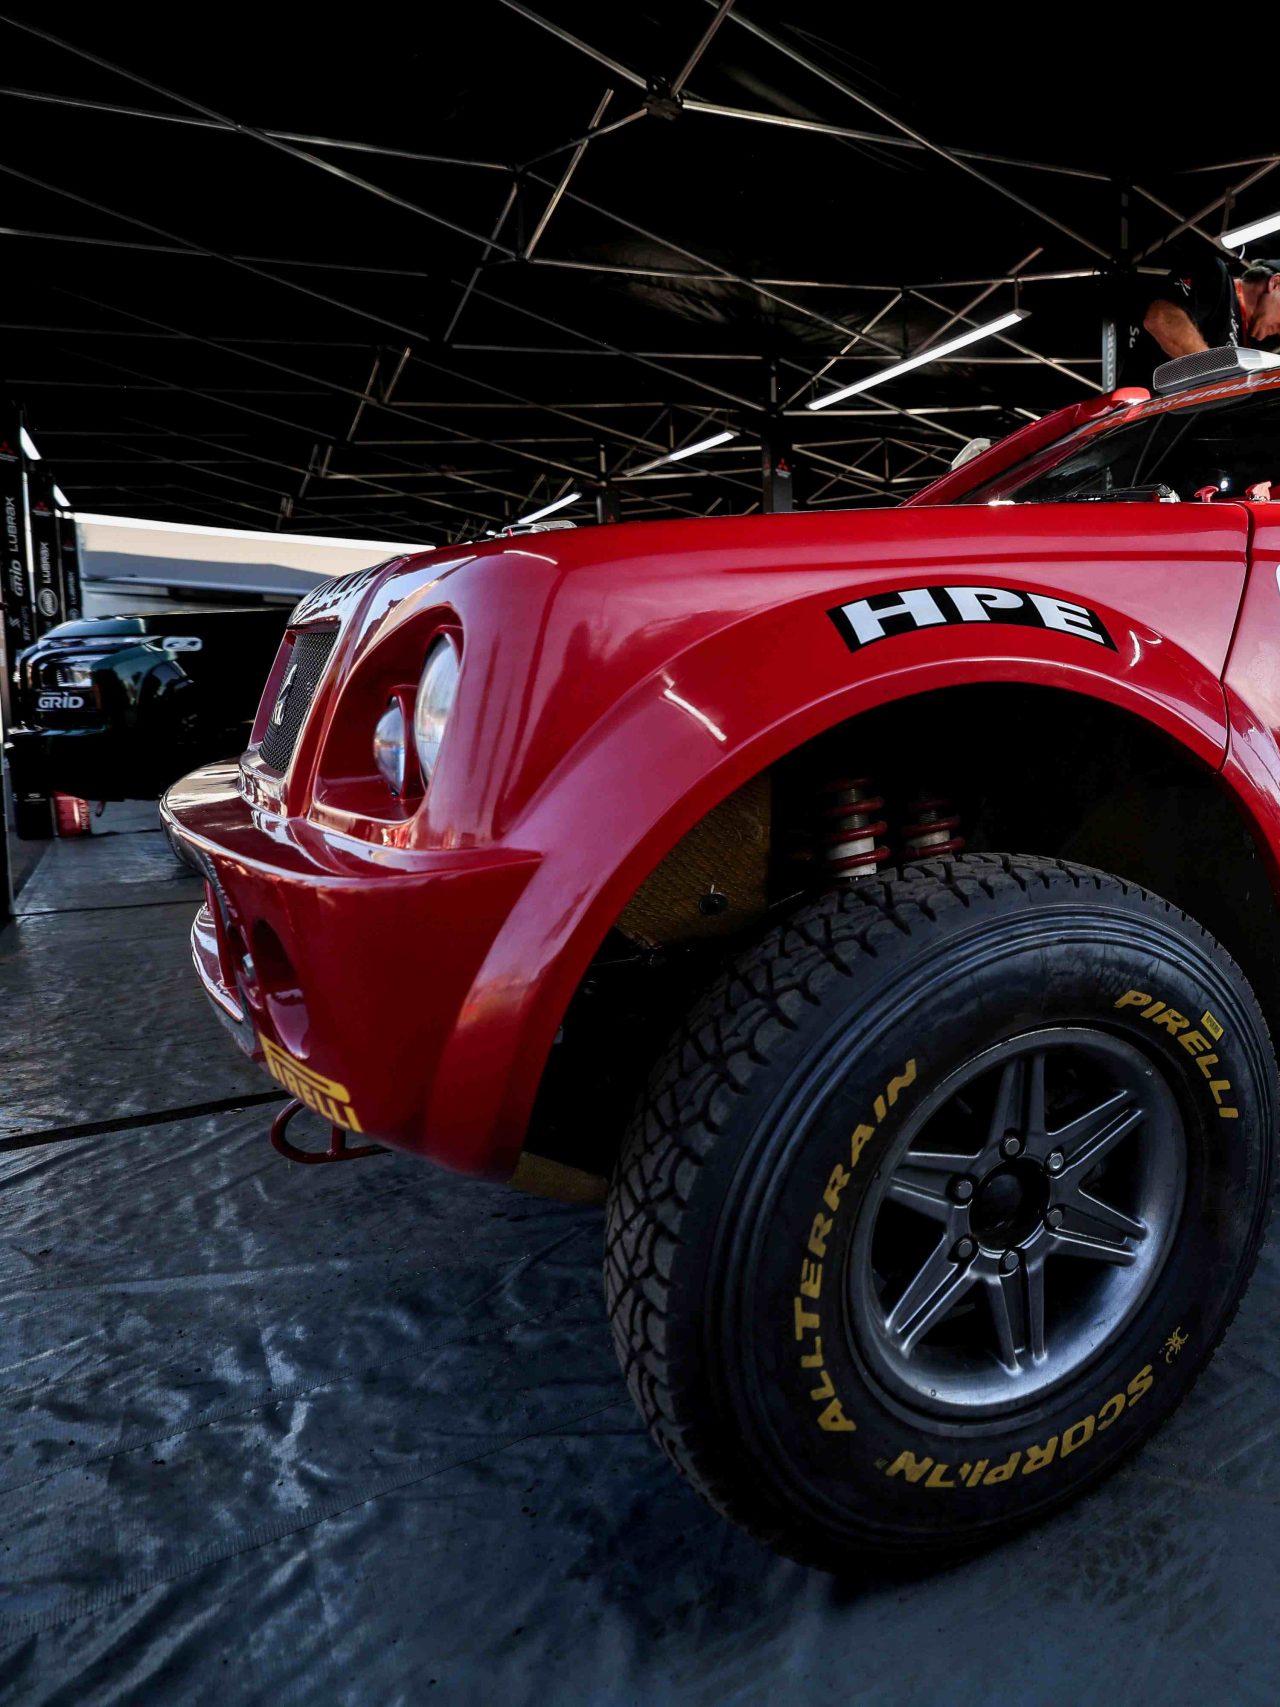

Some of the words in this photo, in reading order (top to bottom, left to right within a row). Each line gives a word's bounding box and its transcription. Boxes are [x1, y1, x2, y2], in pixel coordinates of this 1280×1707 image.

[841, 587, 1105, 645] HPE
[258, 1032, 363, 1133] PIRELLI
[1113, 990, 1239, 1119] PIRELLI
